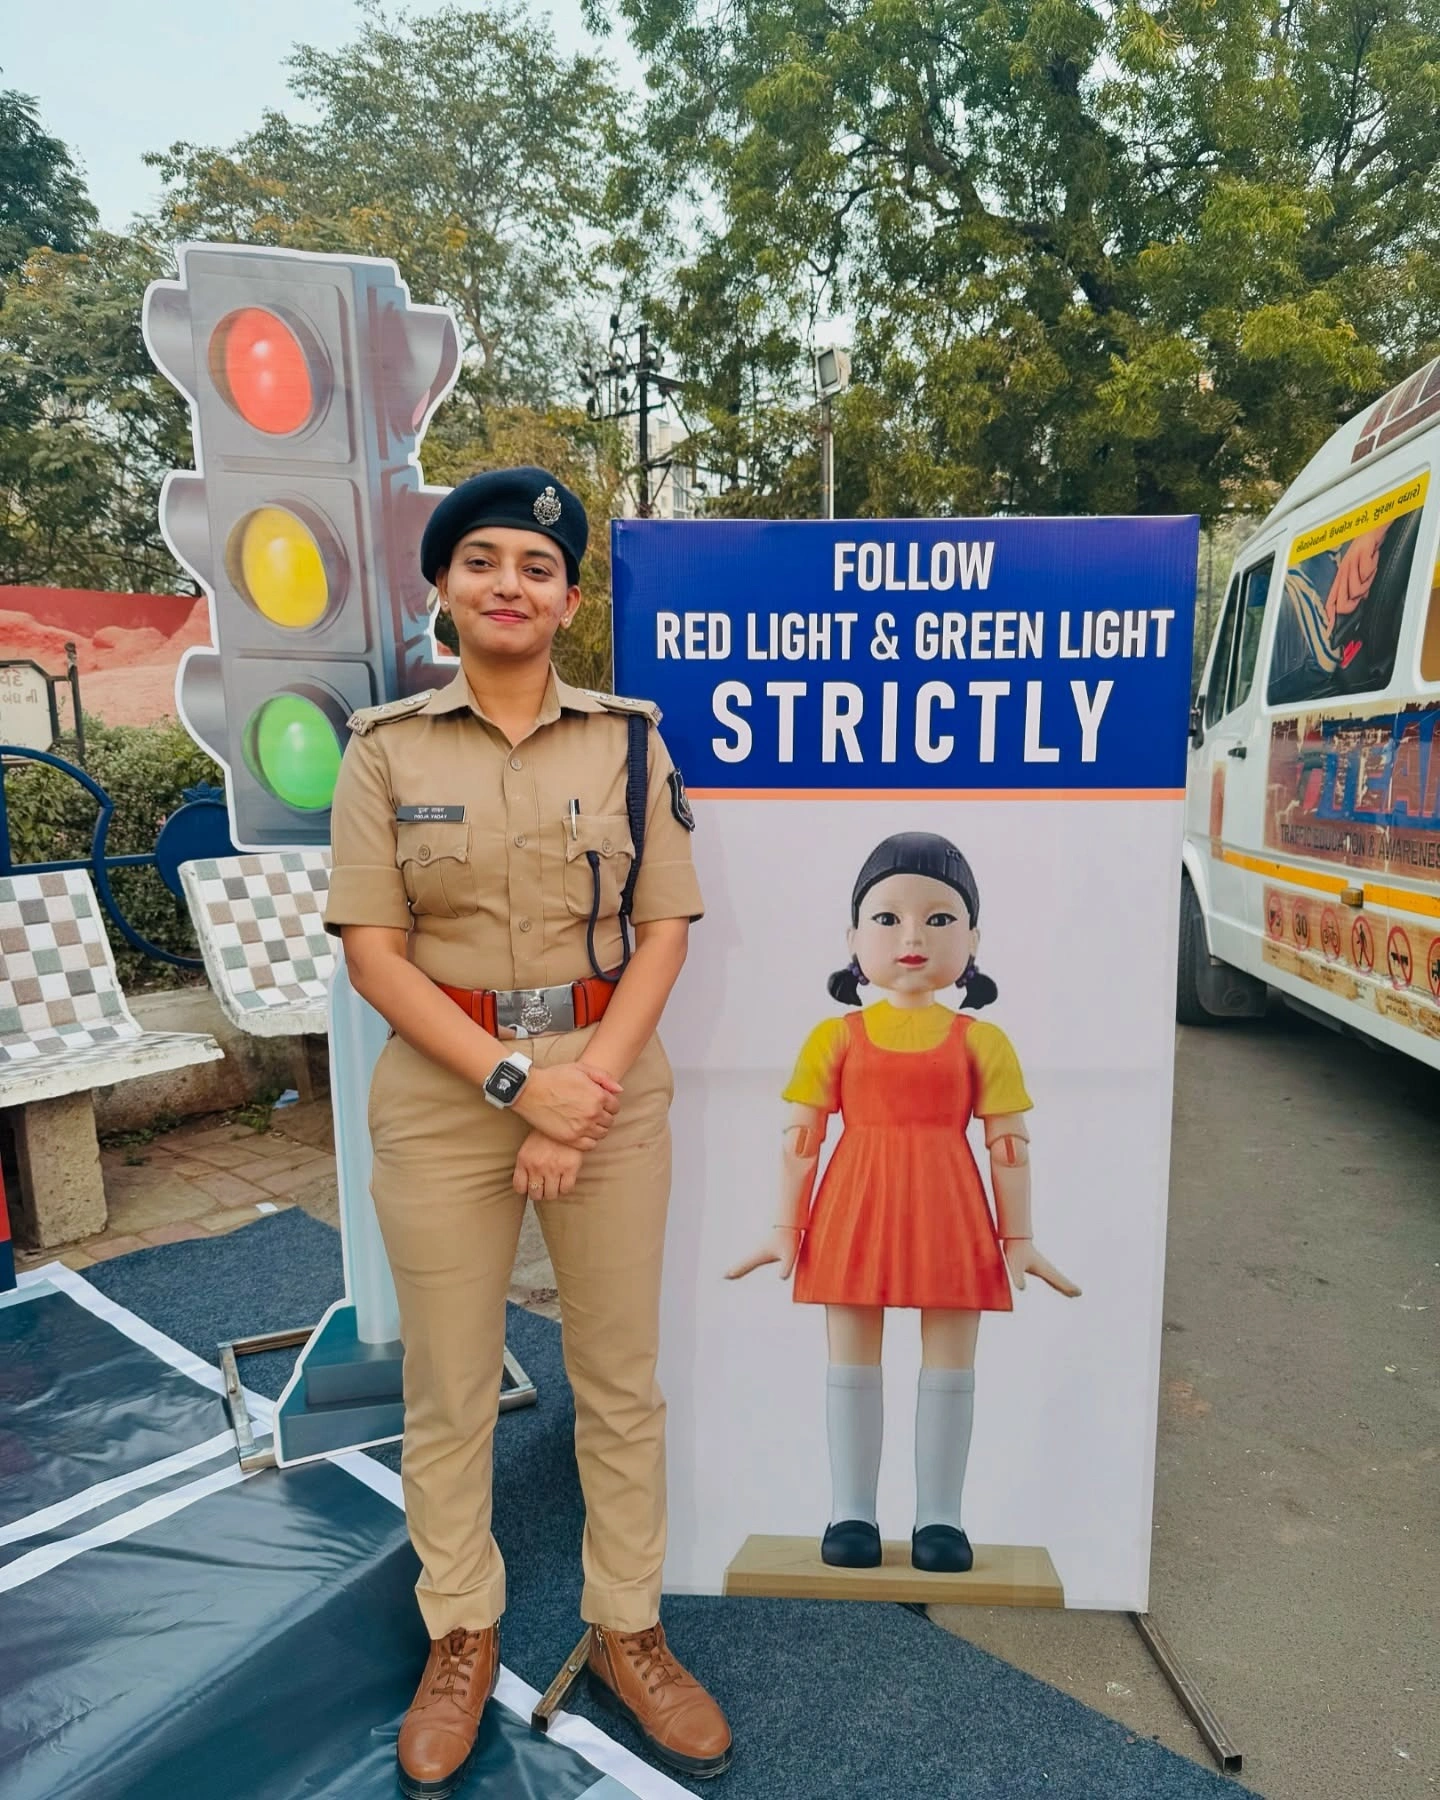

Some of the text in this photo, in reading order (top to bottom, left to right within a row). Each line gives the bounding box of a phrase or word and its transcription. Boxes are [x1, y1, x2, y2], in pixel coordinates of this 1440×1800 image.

[833, 541, 995, 592] FOLLOW
[655, 609, 1175, 660] RED LIGHT & GREEN LIGHT
[712, 680, 1114, 763] STRICTLY
[1295, 912, 1309, 940] 30
